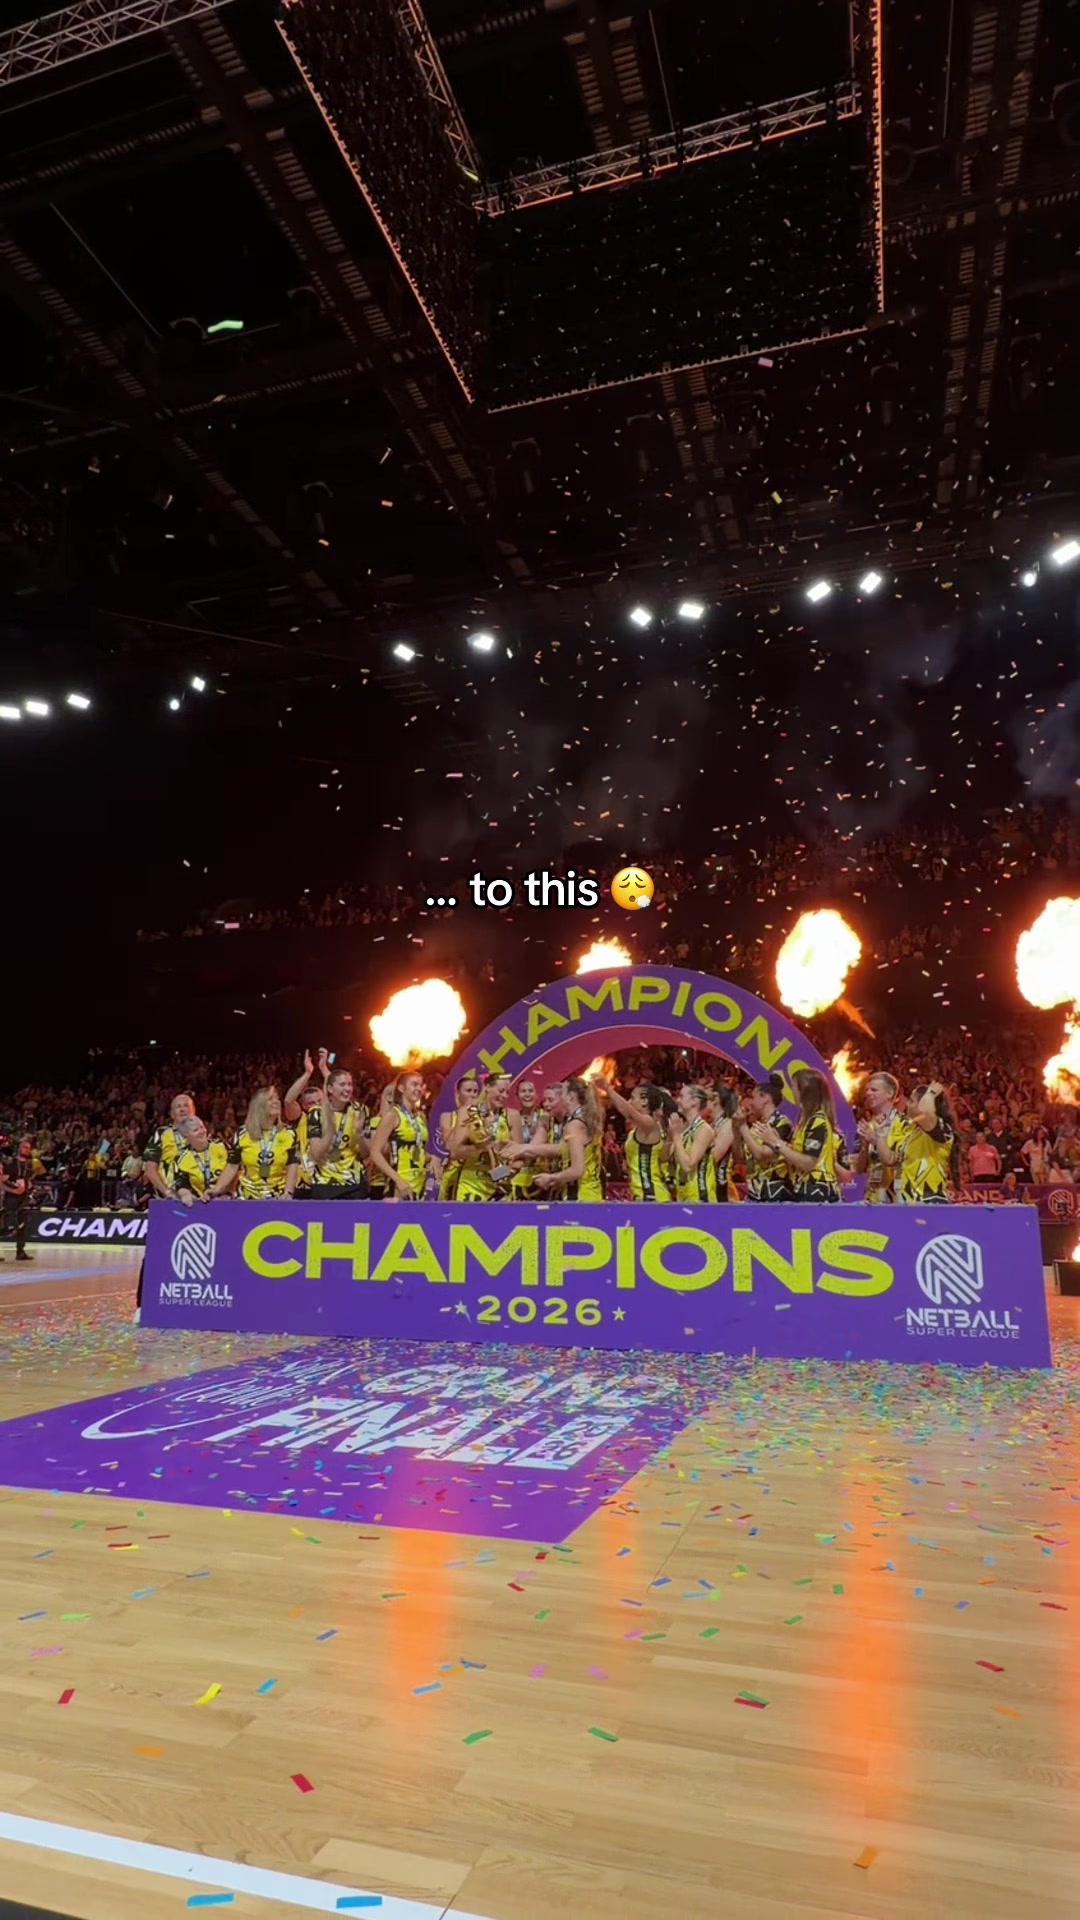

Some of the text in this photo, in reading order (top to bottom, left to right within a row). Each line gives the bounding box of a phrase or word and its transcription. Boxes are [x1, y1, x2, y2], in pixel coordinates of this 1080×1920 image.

[461, 974, 811, 1105] HAMPION
[242, 1221, 895, 1298] CHAMPIONS
[159, 1282, 233, 1300] NETBALL
[159, 1298, 233, 1308] SUPER LEAGUE
[476, 1294, 602, 1327] 2026
[905, 1307, 1020, 1330] NETBALL
[906, 1327, 1020, 1339] SUPER LEAGUE
[362, 1363, 658, 1408] GRAND
[203, 1396, 542, 1466] FINAL
